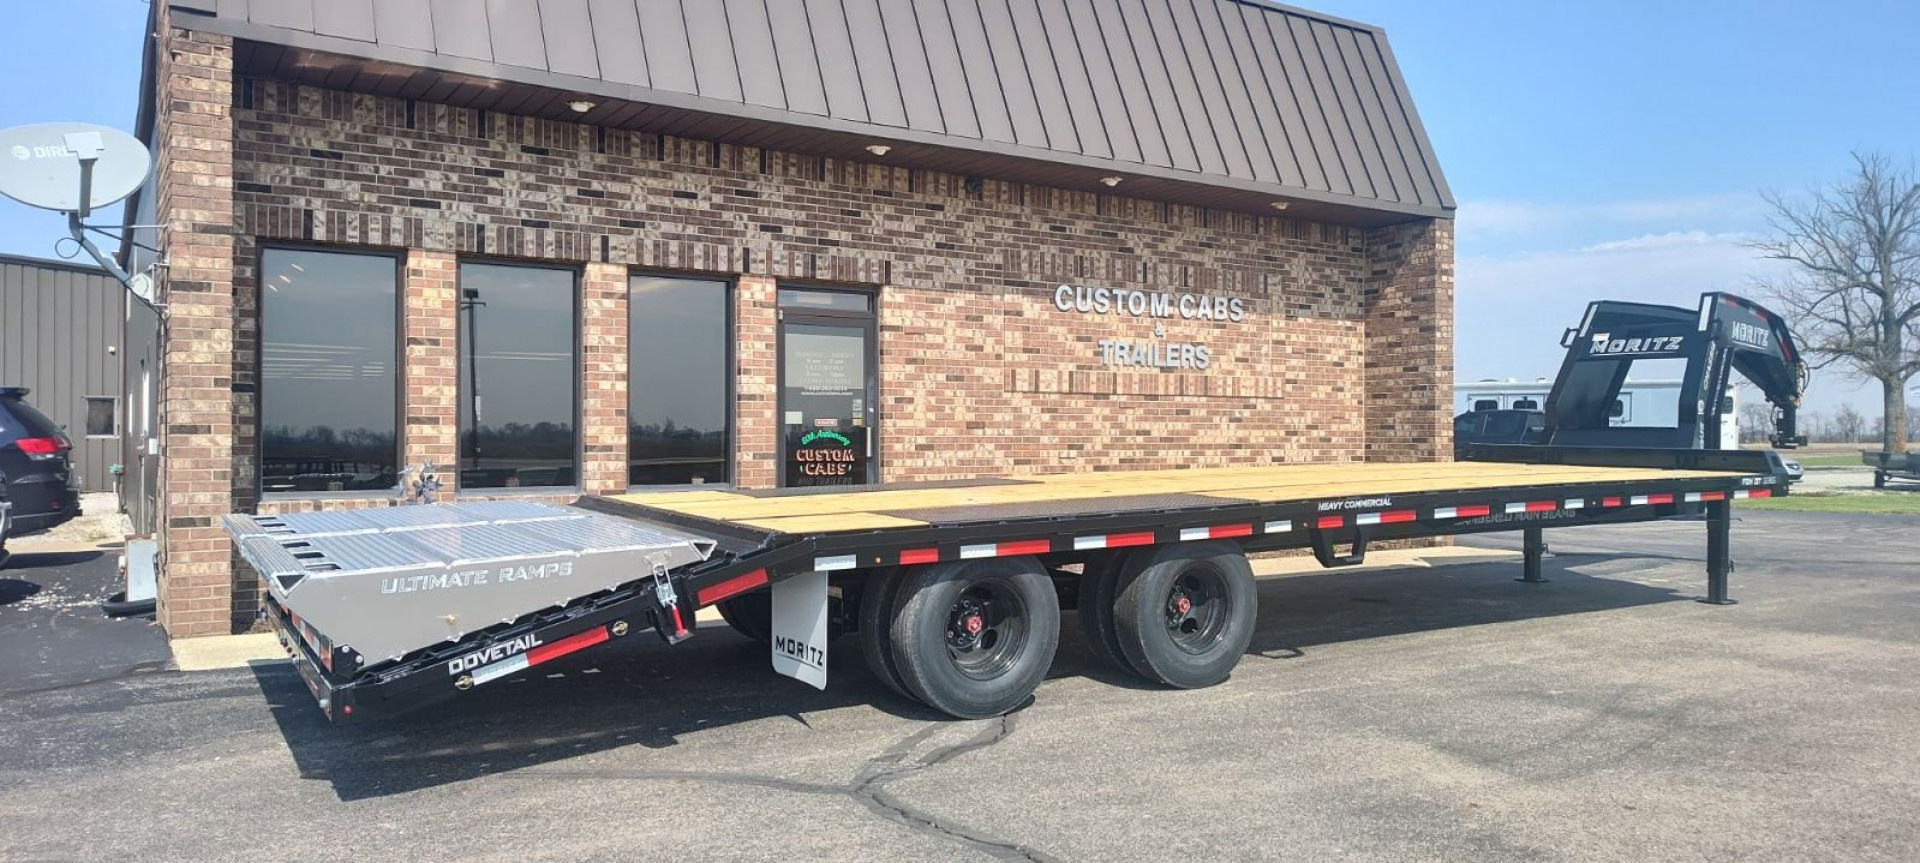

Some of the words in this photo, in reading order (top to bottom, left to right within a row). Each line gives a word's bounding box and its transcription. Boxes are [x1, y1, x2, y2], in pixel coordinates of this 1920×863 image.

[1054, 285, 1169, 318] CUSTOM
[1178, 293, 1245, 322] CABS
[1154, 320, 1165, 338] &
[1731, 320, 1769, 347] MORITZ
[1098, 338, 1210, 370] TRAILERS
[1590, 336, 1684, 354] MORITZ
[796, 448, 855, 462] CUSTOM
[805, 462, 847, 475] CABS
[1317, 501, 1344, 512] HEAVY
[1344, 498, 1393, 510] COMMERCIAL
[1514, 509, 1540, 522] MAIN
[381, 568, 490, 595] ULTIMATE
[499, 561, 574, 584] RAMPS
[448, 633, 544, 676] DOVETAIL
[775, 634, 824, 667] MORITZ
